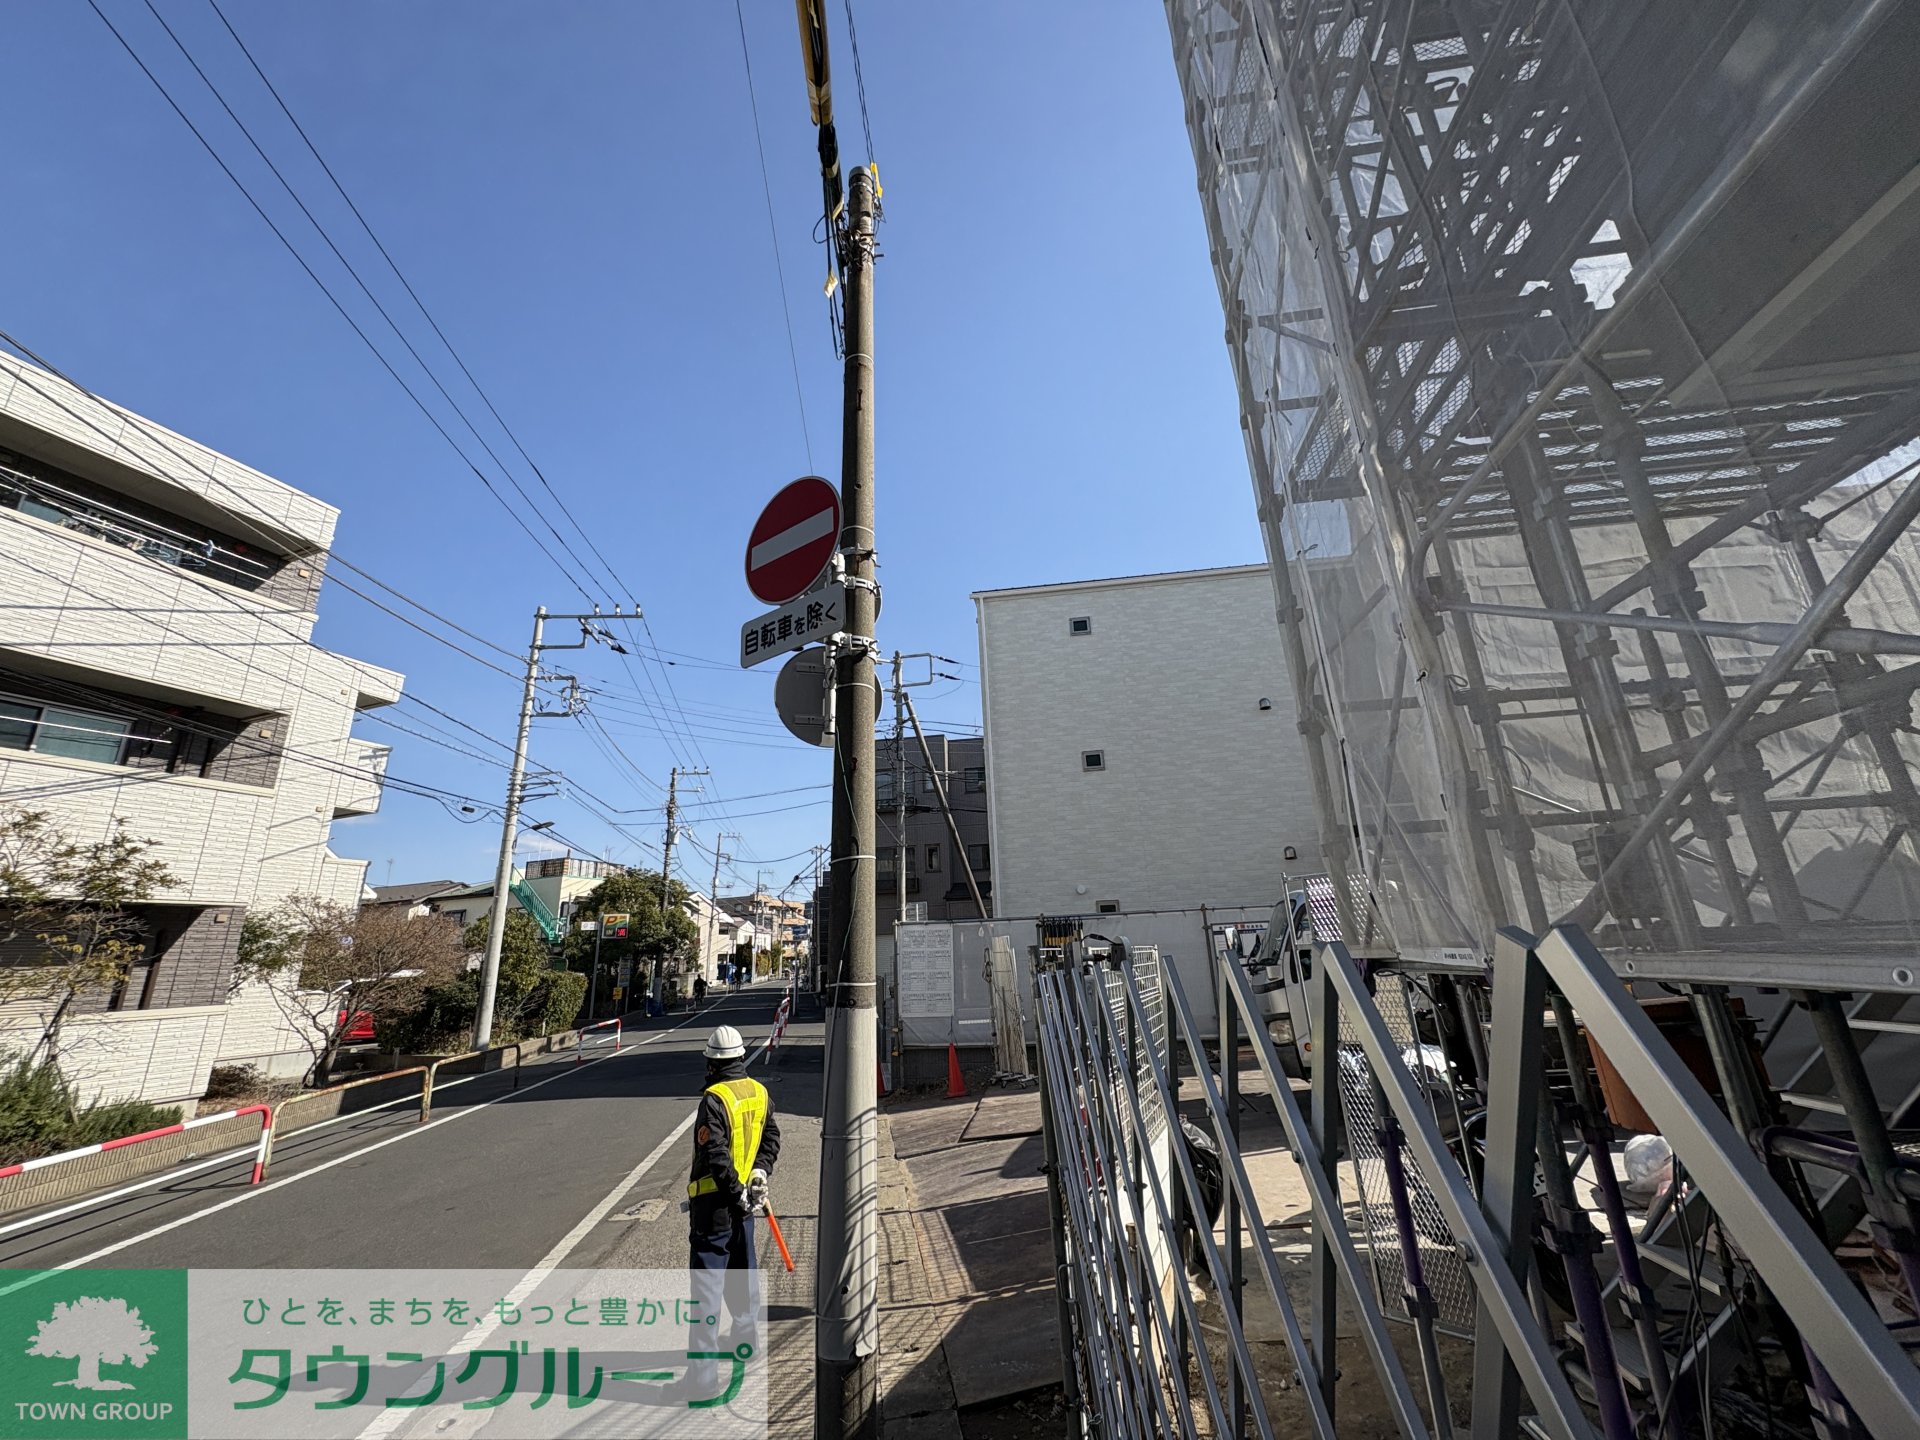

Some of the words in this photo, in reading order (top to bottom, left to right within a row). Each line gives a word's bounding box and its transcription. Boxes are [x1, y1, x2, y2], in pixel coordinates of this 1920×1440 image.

[745, 601, 837, 656] 自転車を除く
